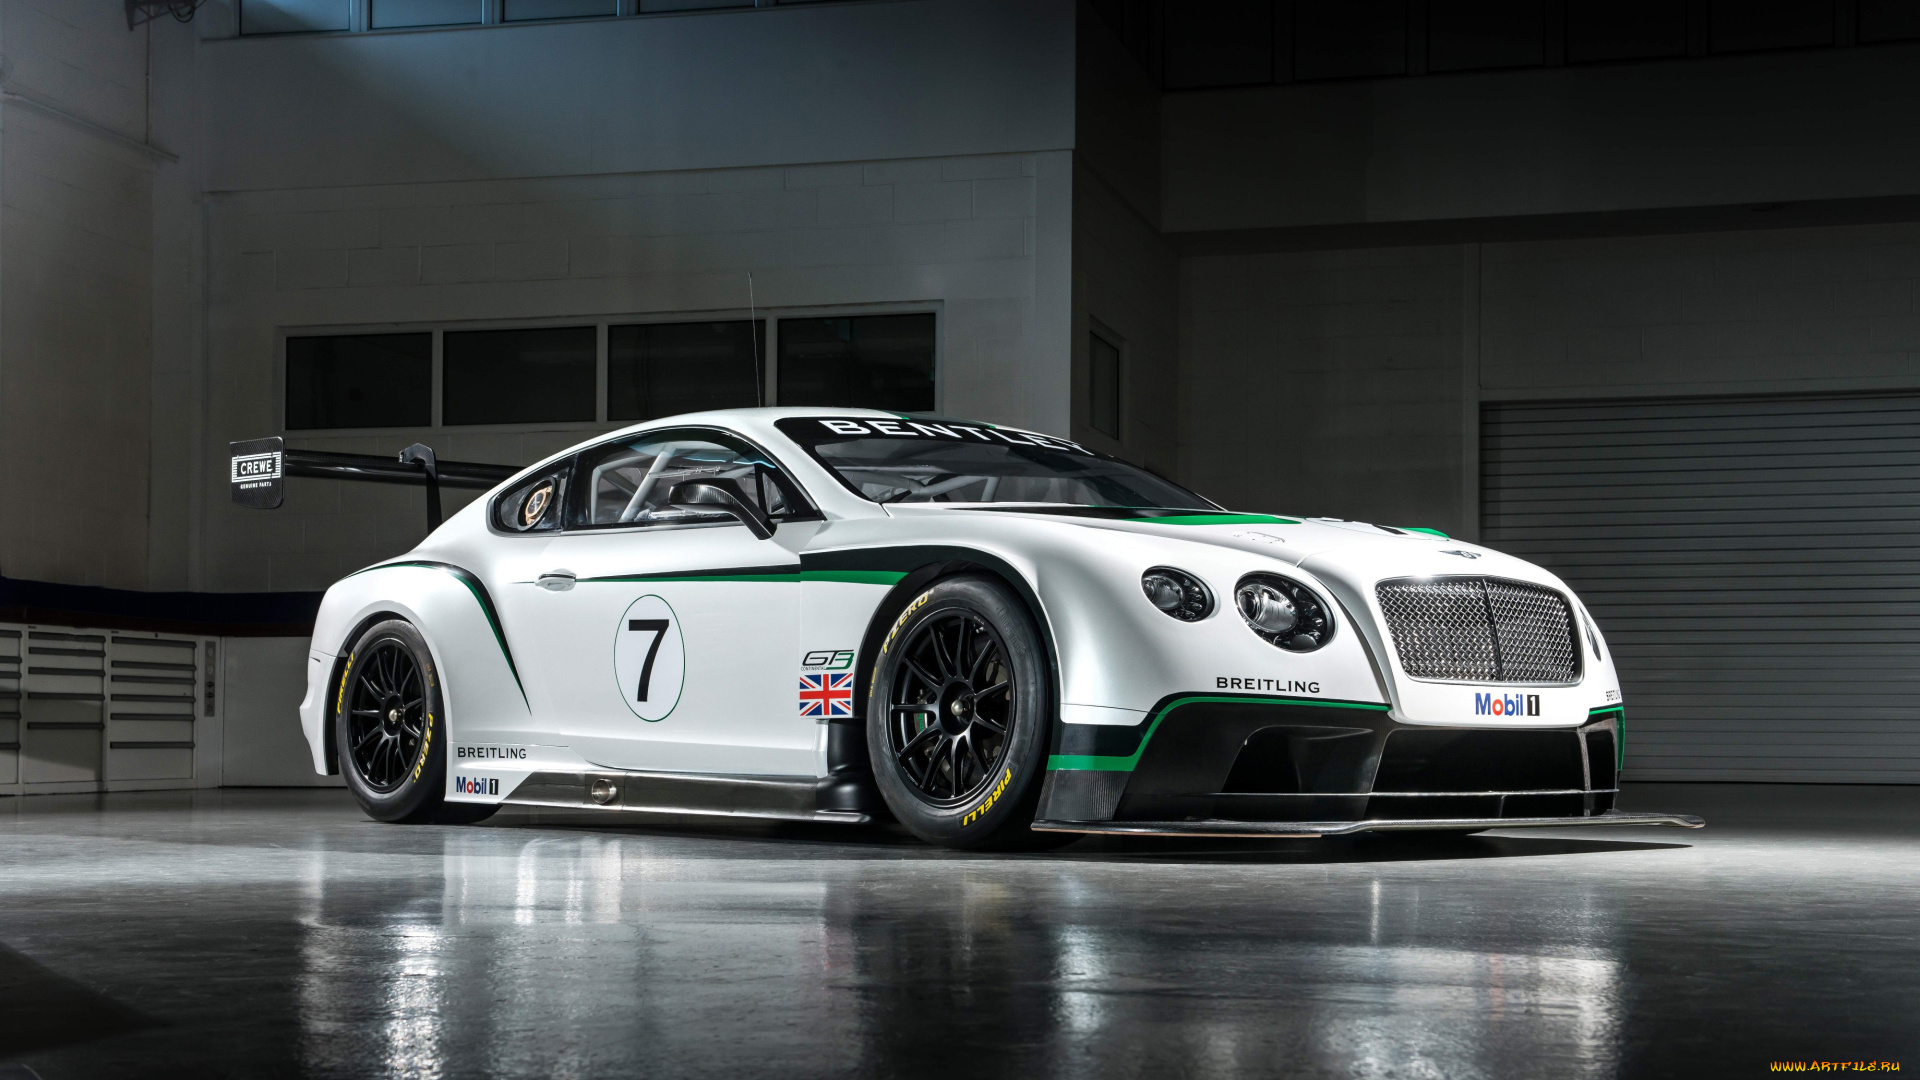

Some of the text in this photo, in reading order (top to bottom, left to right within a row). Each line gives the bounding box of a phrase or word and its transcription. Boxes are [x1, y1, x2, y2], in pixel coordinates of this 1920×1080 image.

[818, 420, 1095, 456] BENTLEY
[240, 460, 273, 475] CREWE
[628, 618, 670, 702] 7
[802, 649, 855, 670] GT3
[336, 652, 354, 714] PIRELLI
[1216, 676, 1321, 694] BREITLING
[1474, 692, 1524, 717] Mobil
[457, 746, 527, 760] BREITLING
[456, 776, 487, 795] Mobil
[963, 767, 1012, 826] PIRELLI
